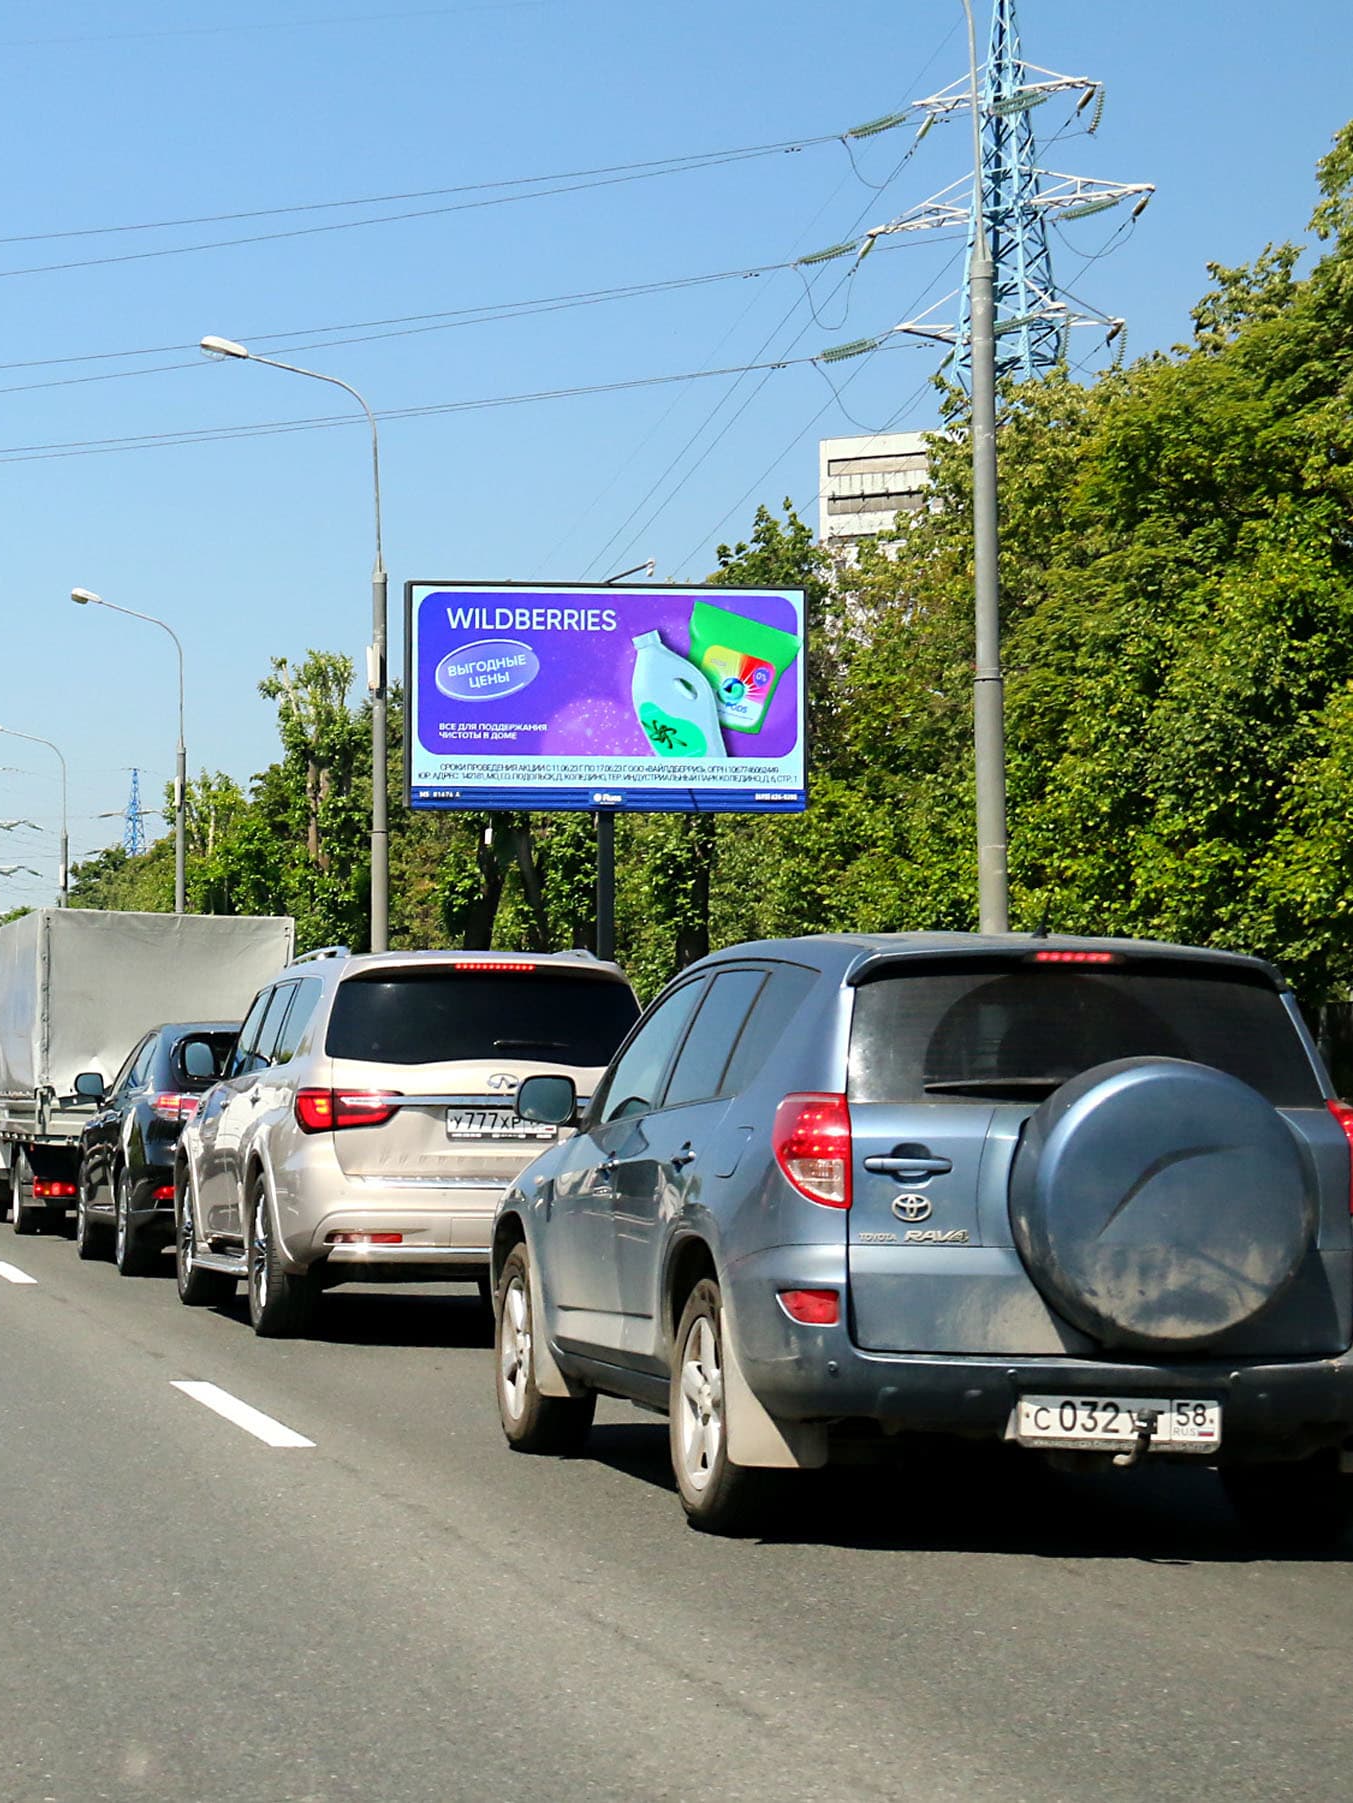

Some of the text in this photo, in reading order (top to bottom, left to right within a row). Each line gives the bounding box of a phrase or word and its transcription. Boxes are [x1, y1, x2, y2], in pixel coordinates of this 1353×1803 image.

[446, 607, 617, 632] WILDBERRIES
[447, 654, 527, 677] ВЫГОДНЫЕ
[468, 671, 510, 689] ЦЕНЫ
[438, 722, 548, 732] ВСЕ ДЛЯ ПОДДЕРЖАНИЯ
[438, 731, 481, 740] ЧИСТОТЫ
[490, 732, 518, 740] ДОМЕ
[440, 763, 466, 771] СРОКИ
[468, 763, 518, 772] ПРОВЕДЕНИЯ
[454, 1112, 521, 1130] У777ХР
[858, 1229, 969, 1244] TOYOTA RAV4
[1175, 1402, 1208, 1427] 58
[1173, 1427, 1197, 1437] RUS
